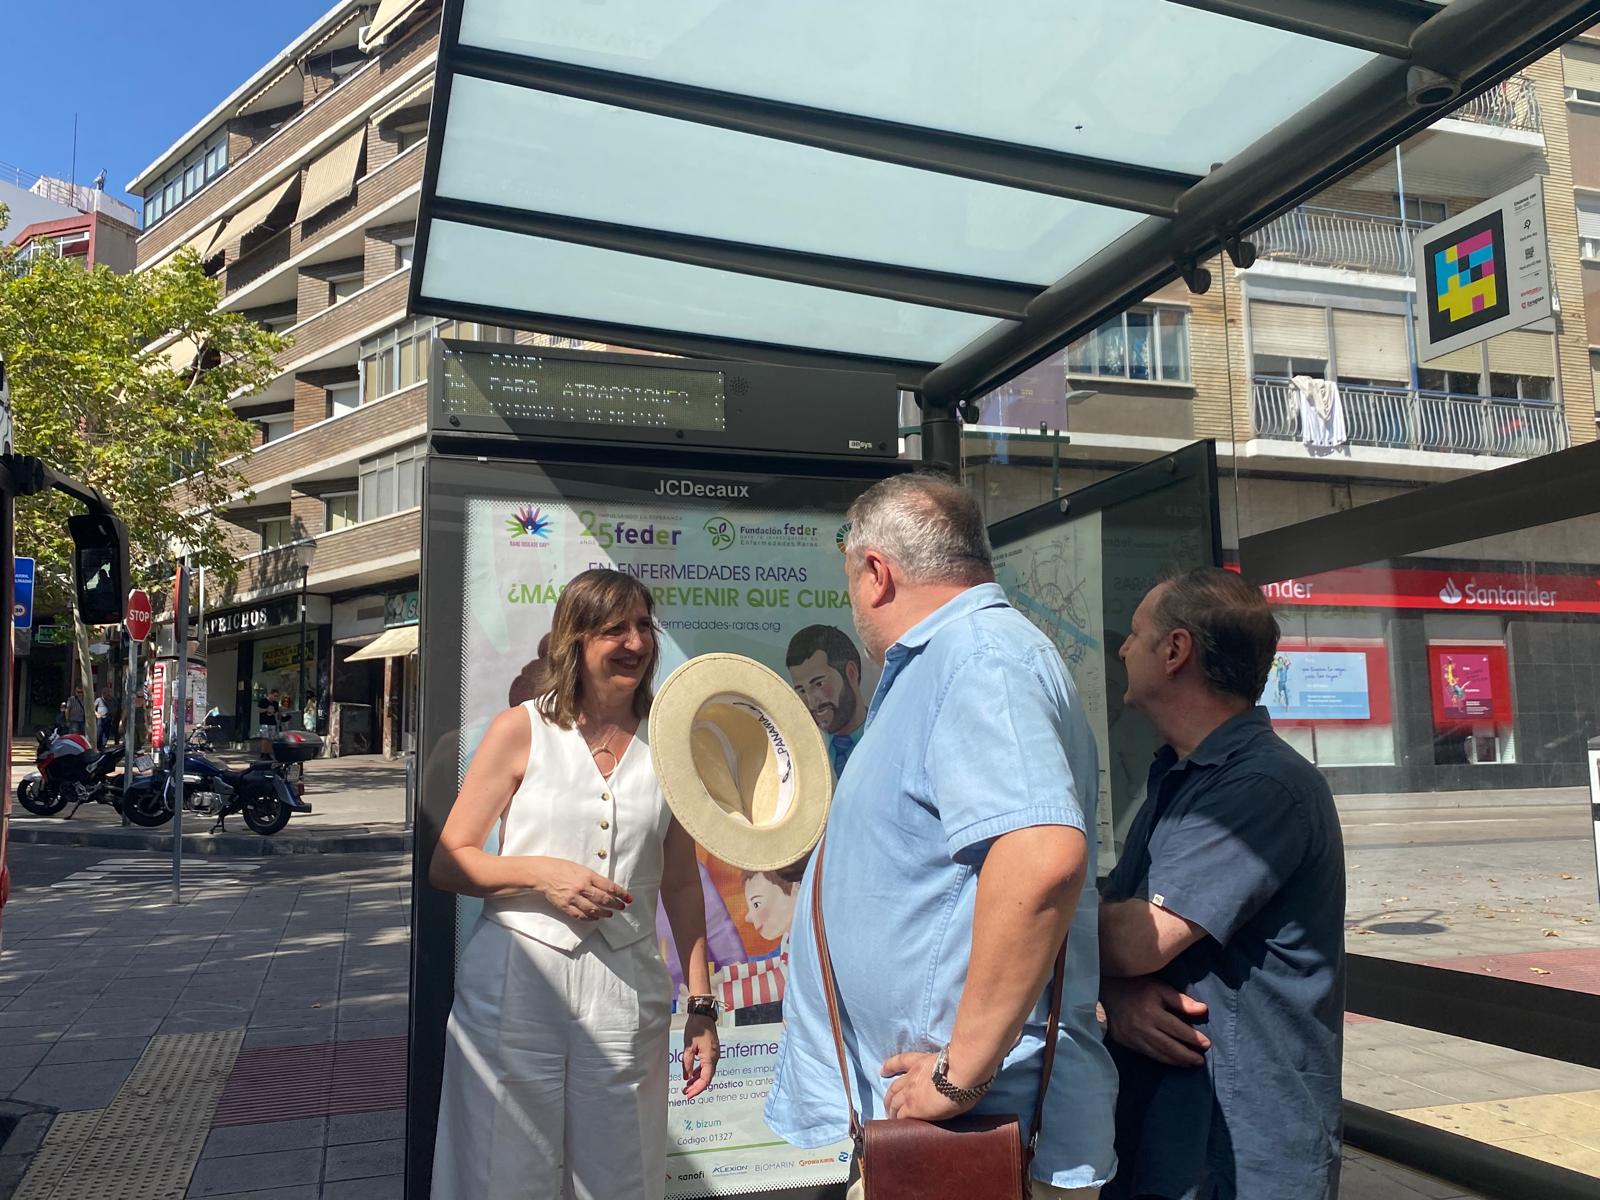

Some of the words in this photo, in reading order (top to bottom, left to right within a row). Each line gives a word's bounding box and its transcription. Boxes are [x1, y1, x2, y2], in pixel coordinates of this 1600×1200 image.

[654, 479, 749, 498] JCDecaux
[615, 522, 682, 546] feder
[740, 526, 783, 535] Fundación
[783, 523, 818, 536] feder
[618, 563, 750, 581] ENFERMEDADES
[755, 566, 808, 582] RARAS
[652, 586, 739, 607] REVENIR
[746, 588, 790, 608] QUE
[796, 589, 853, 609] CURA
[1465, 583, 1557, 607] Santander
[129, 610, 150, 622] STOP
[204, 607, 268, 635] APRICHOS
[758, 714, 788, 755] PANAMA
[718, 1042, 779, 1059] Enferme
[714, 1068, 741, 1077] mbién
[754, 1065, 774, 1073] impu
[705, 1081, 744, 1092] gnóstico
[668, 1097, 696, 1107] miento
[698, 1096, 714, 1105] que
[716, 1094, 738, 1103] frene
[696, 1119, 722, 1128] bizum
[677, 1136, 708, 1146] Código:
[709, 1132, 733, 1142] 01327
[677, 1170, 705, 1181] sanofi
[712, 1164, 748, 1174] ALEXION
